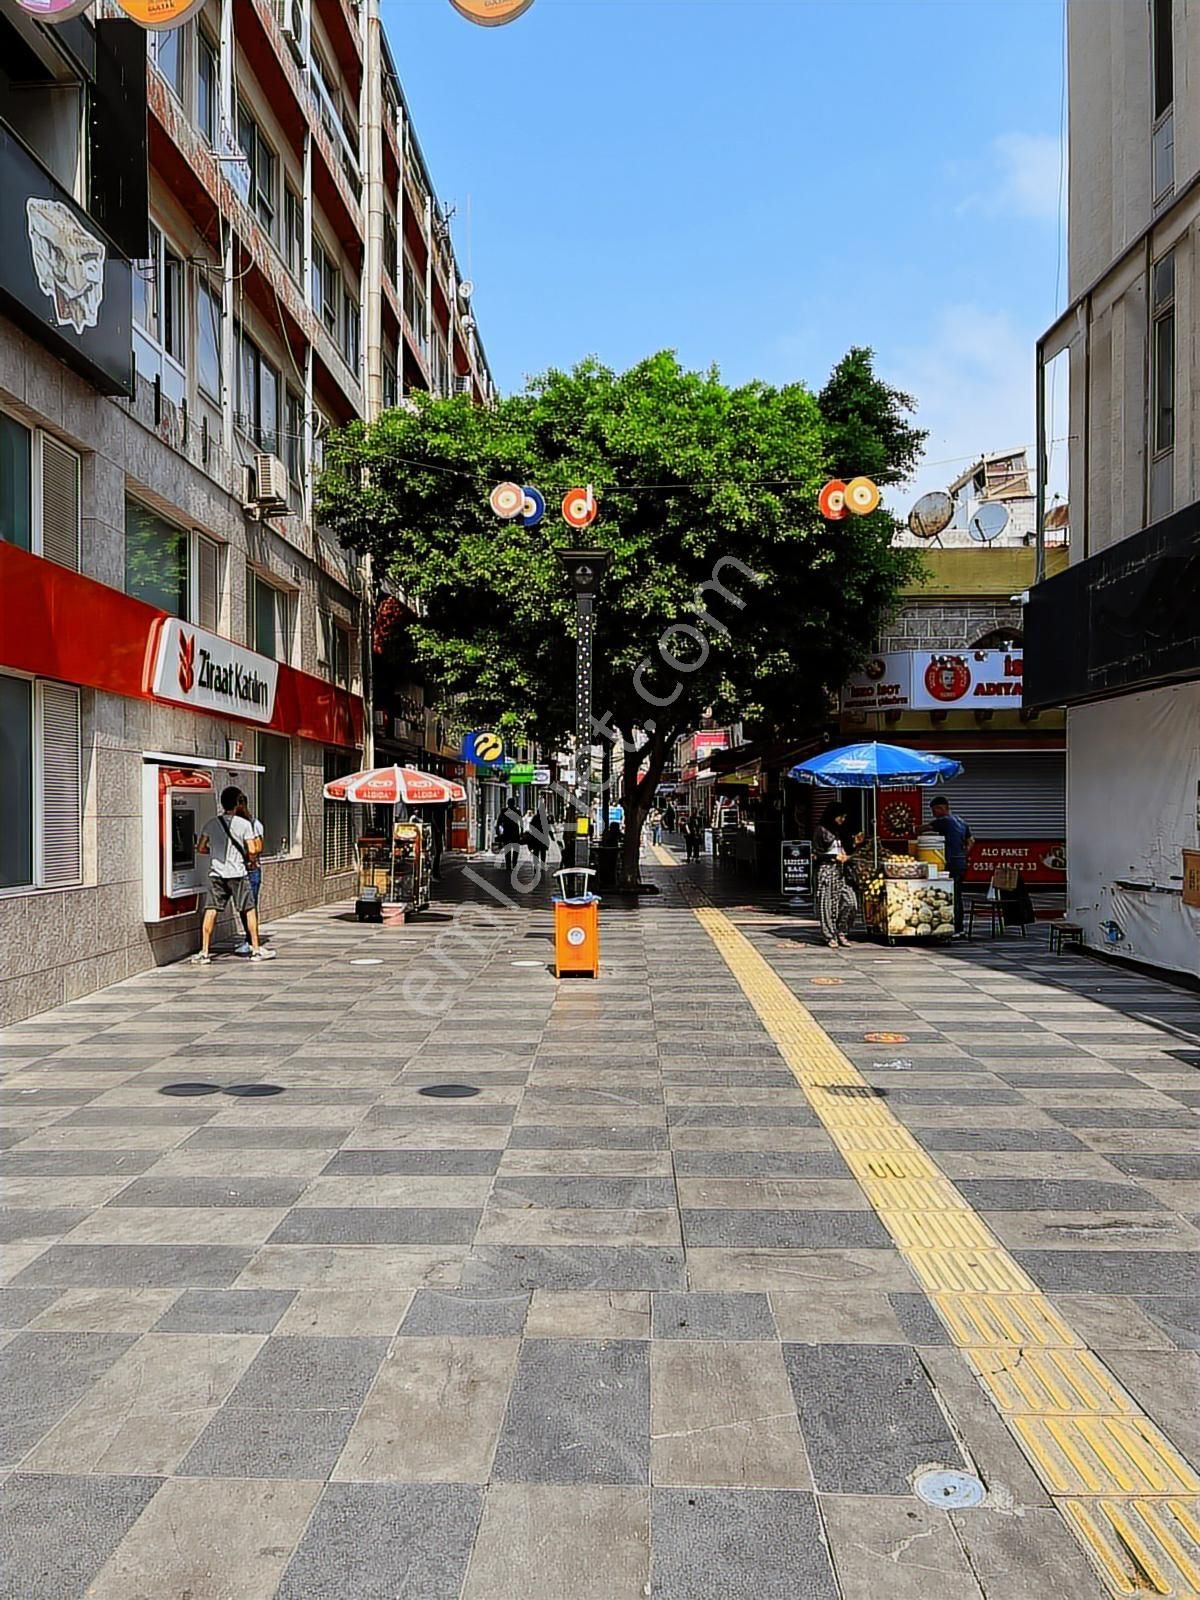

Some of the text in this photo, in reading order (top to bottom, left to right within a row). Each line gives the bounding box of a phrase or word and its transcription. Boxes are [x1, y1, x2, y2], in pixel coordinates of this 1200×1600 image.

[198, 648, 234, 697] Ziraat
[981, 848, 1029, 857] ALO PAKET
